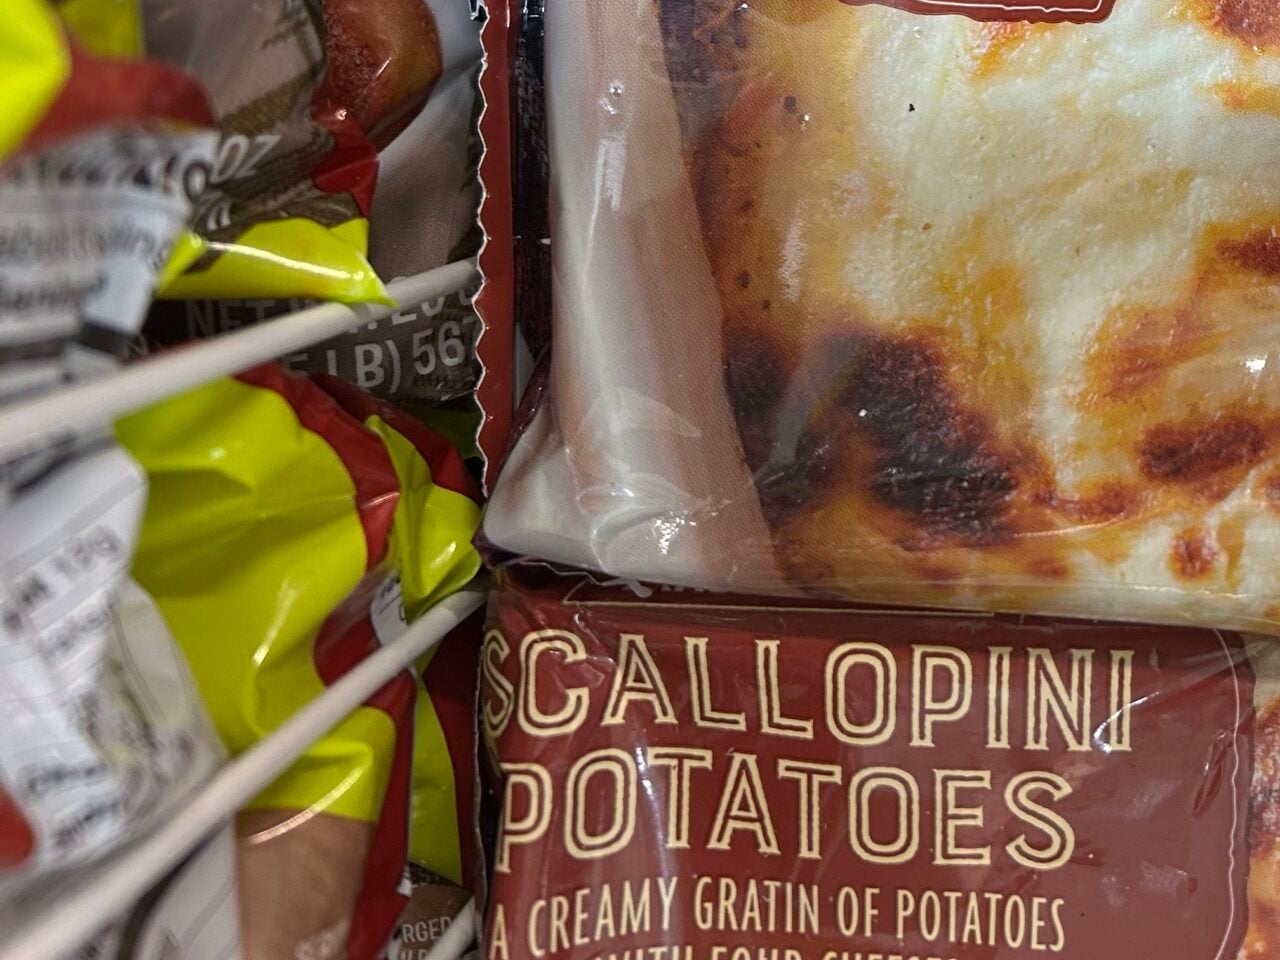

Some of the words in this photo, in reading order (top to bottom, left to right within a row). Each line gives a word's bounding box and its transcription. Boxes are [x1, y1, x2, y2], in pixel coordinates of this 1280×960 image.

[482, 628, 1134, 753] SCALLOPINI
[494, 746, 1077, 873] POTATOES
[488, 903, 510, 960] A
[526, 876, 679, 958] CREAMY
[693, 875, 820, 935] GRATIN
[836, 885, 880, 939] OF
[896, 888, 1066, 954] POTATOES
